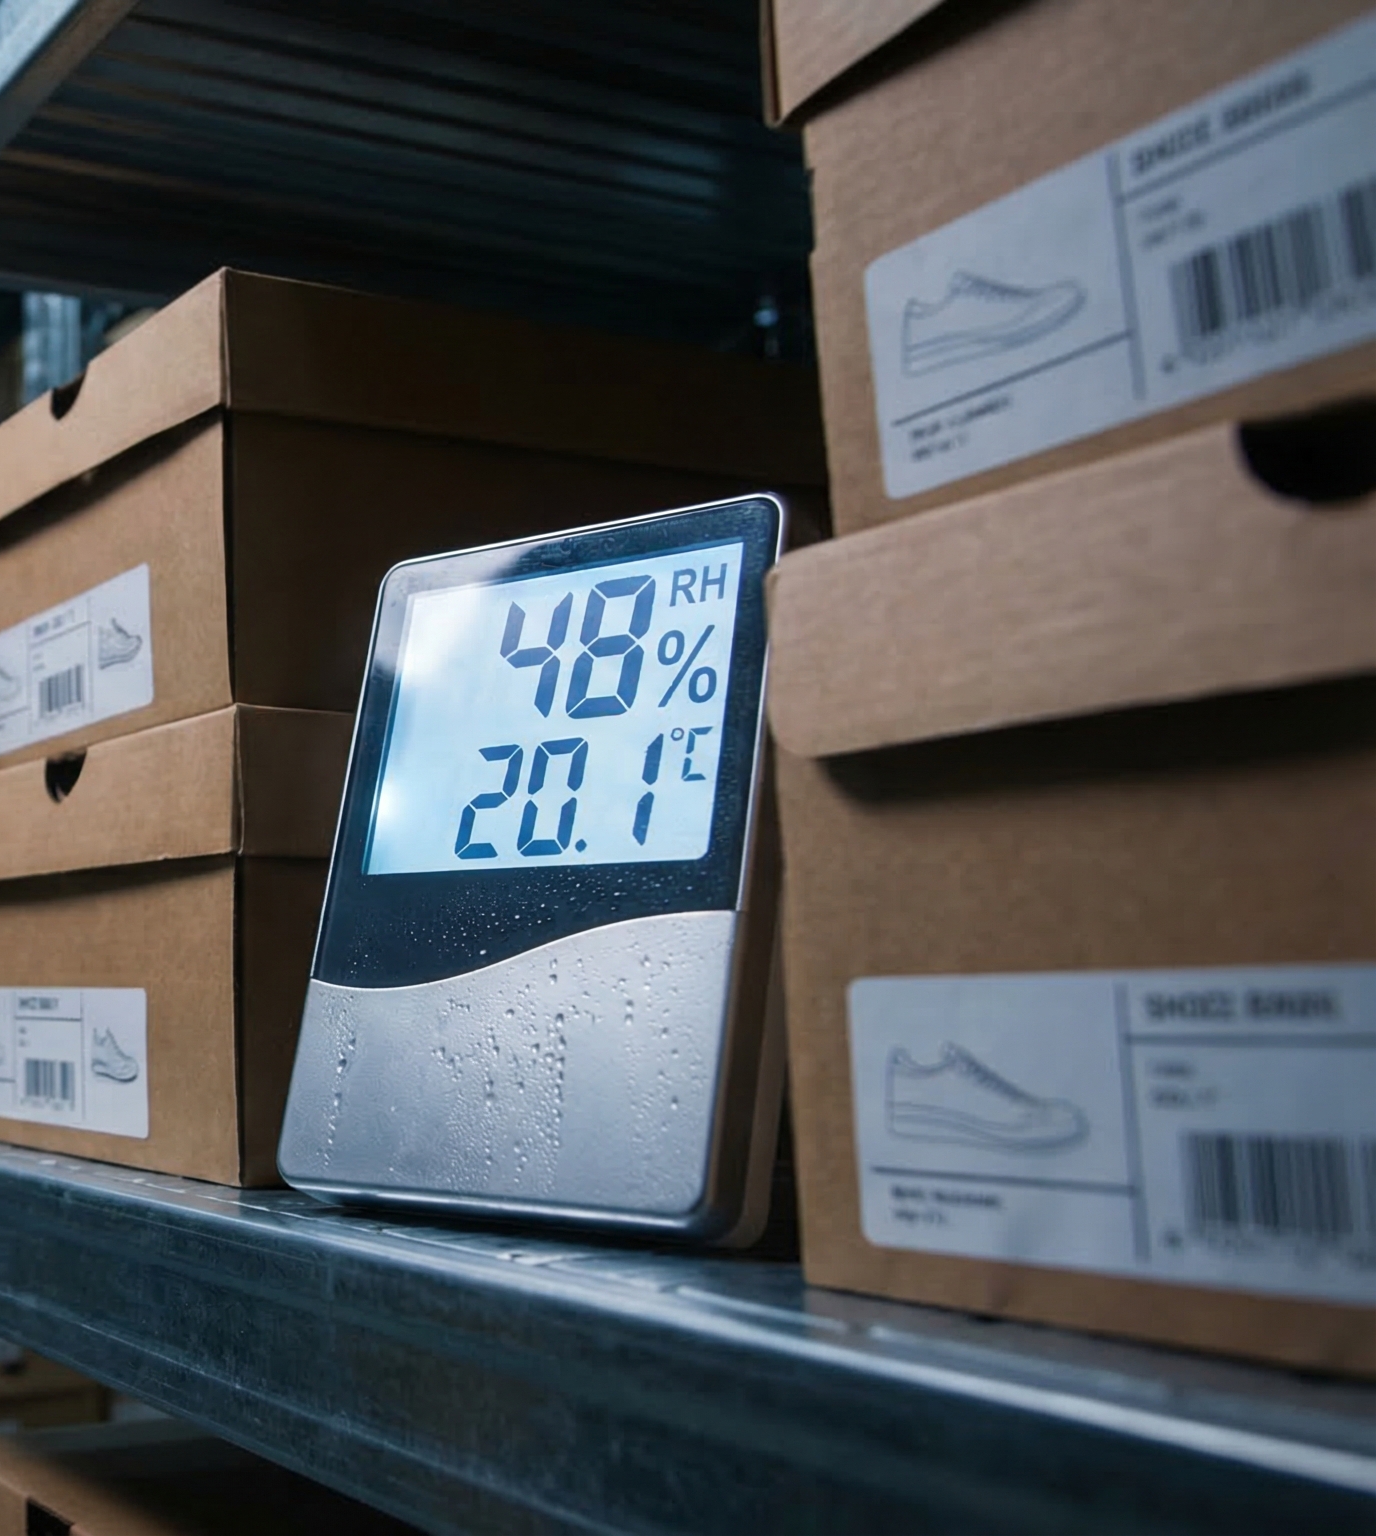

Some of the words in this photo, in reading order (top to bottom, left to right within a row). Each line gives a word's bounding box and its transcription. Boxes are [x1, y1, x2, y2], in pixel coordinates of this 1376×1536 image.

[500, 574, 656, 719] 48
[670, 563, 728, 607] RH
[454, 733, 663, 860] 20.1
